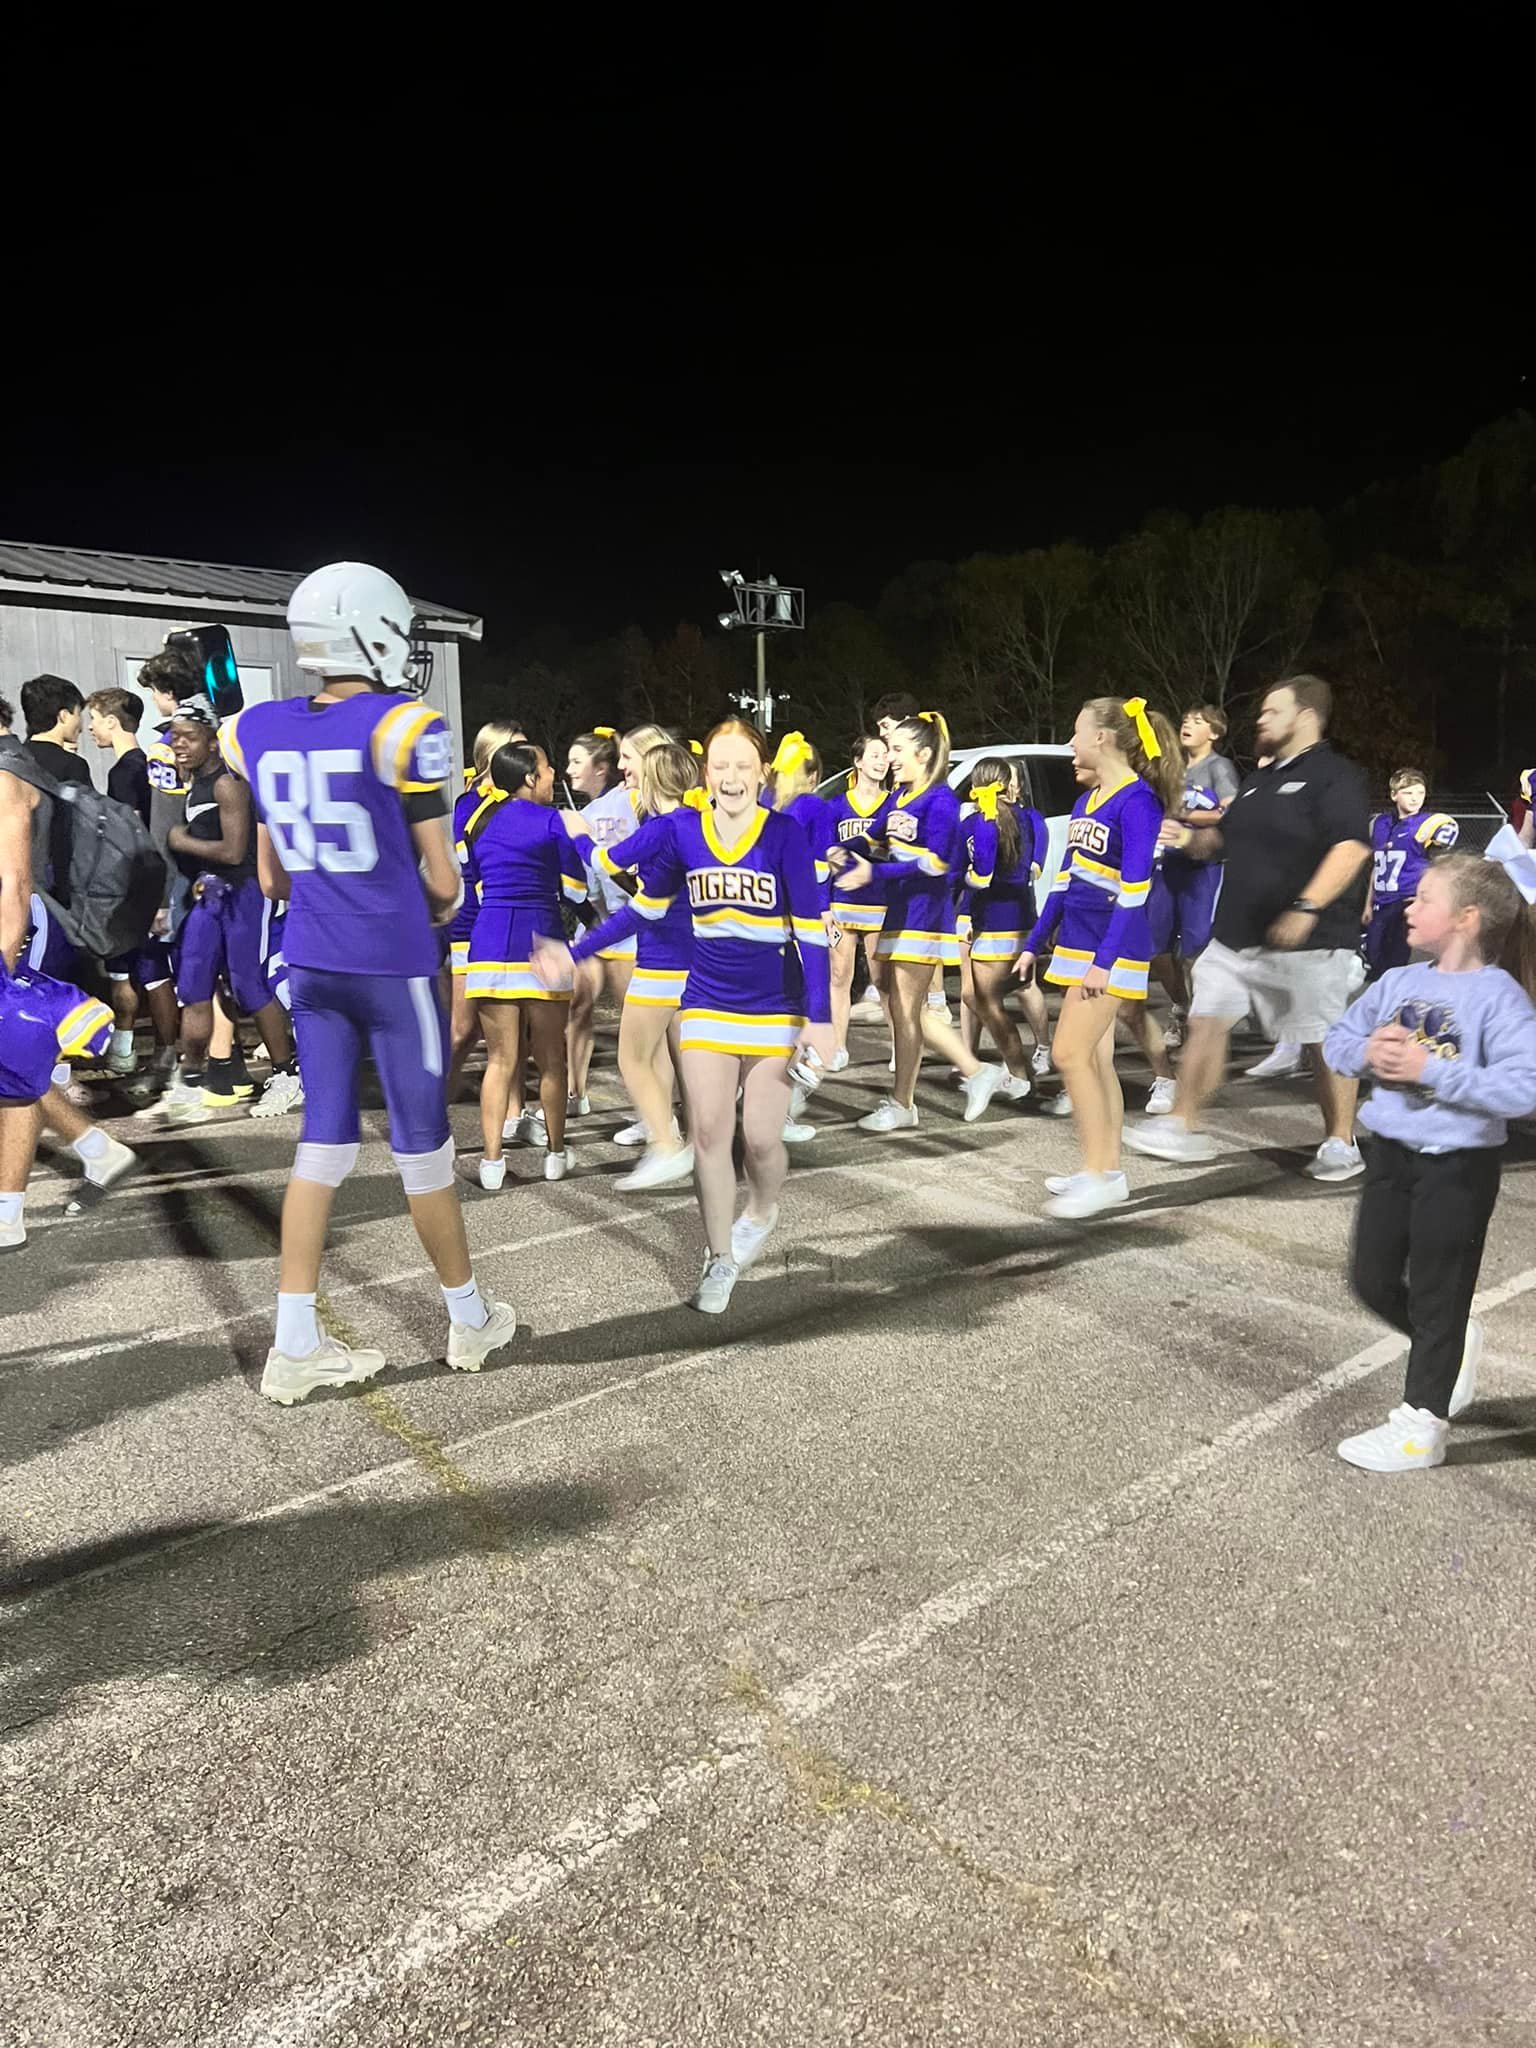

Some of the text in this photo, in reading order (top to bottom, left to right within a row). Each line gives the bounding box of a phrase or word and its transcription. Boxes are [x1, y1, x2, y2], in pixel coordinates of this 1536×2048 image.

[257, 749, 380, 872] 85
[688, 870, 774, 908] TIGERS
[1374, 850, 1406, 891] 27
